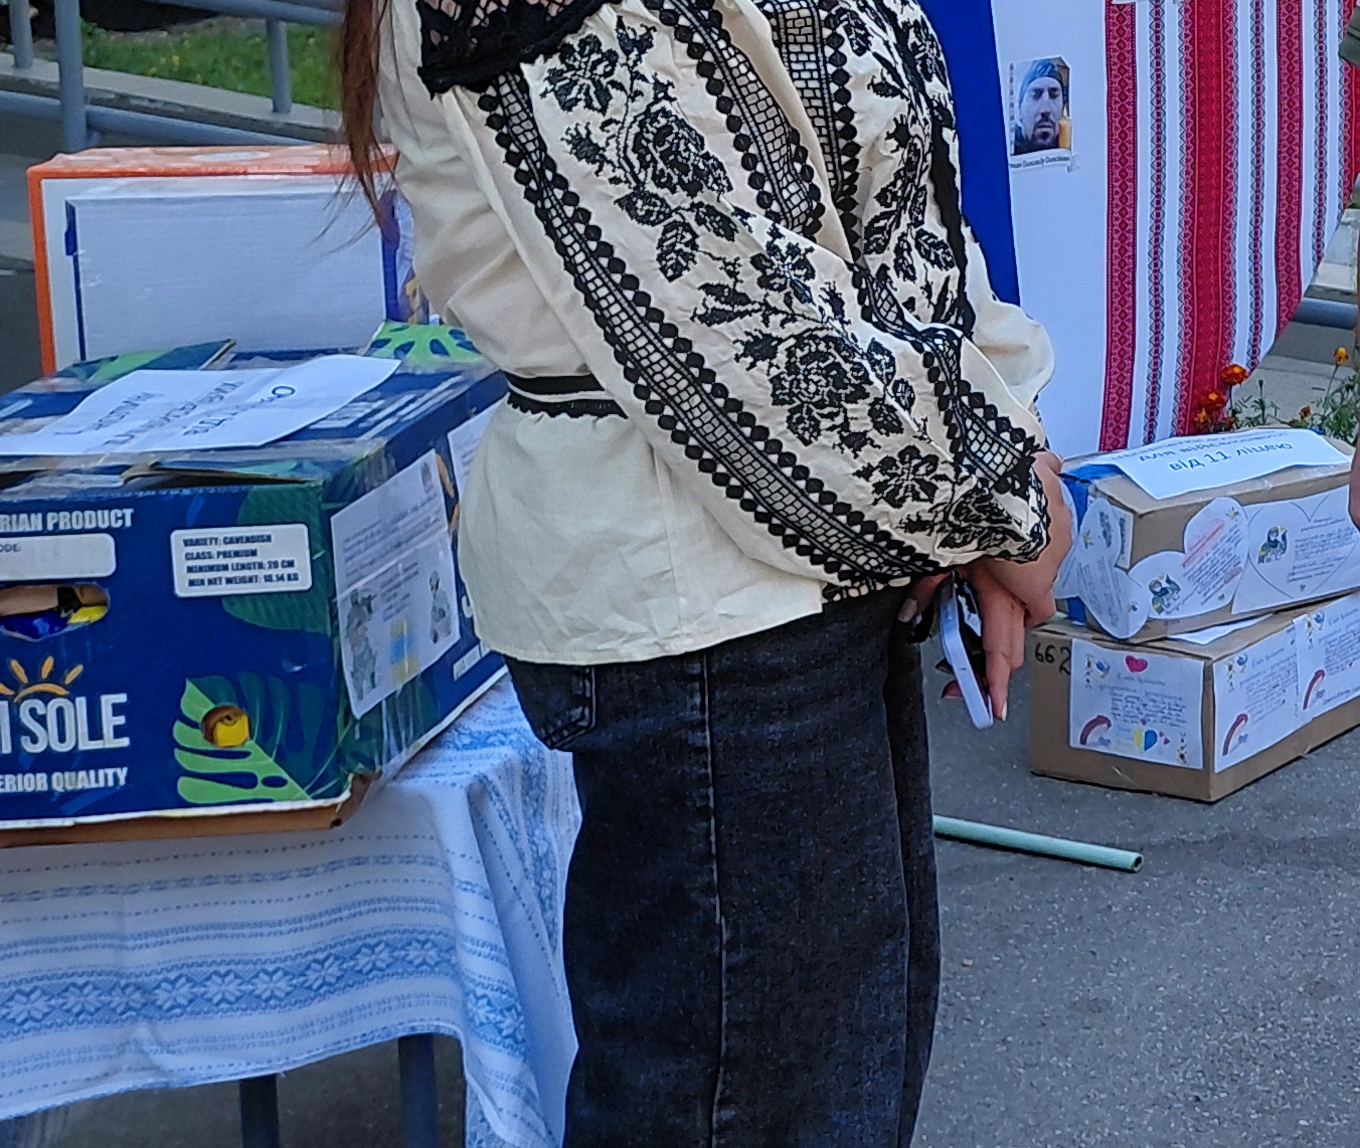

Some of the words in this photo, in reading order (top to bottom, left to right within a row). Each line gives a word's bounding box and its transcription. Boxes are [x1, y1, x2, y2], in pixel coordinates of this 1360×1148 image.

[1168, 455, 1206, 471] від
[1201, 450, 1231, 466] 11
[46, 508, 135, 531] PRODUCT
[281, 559, 295, 568] CM
[20, 693, 130, 754] SOLE
[51, 766, 129, 793] QUALITY
